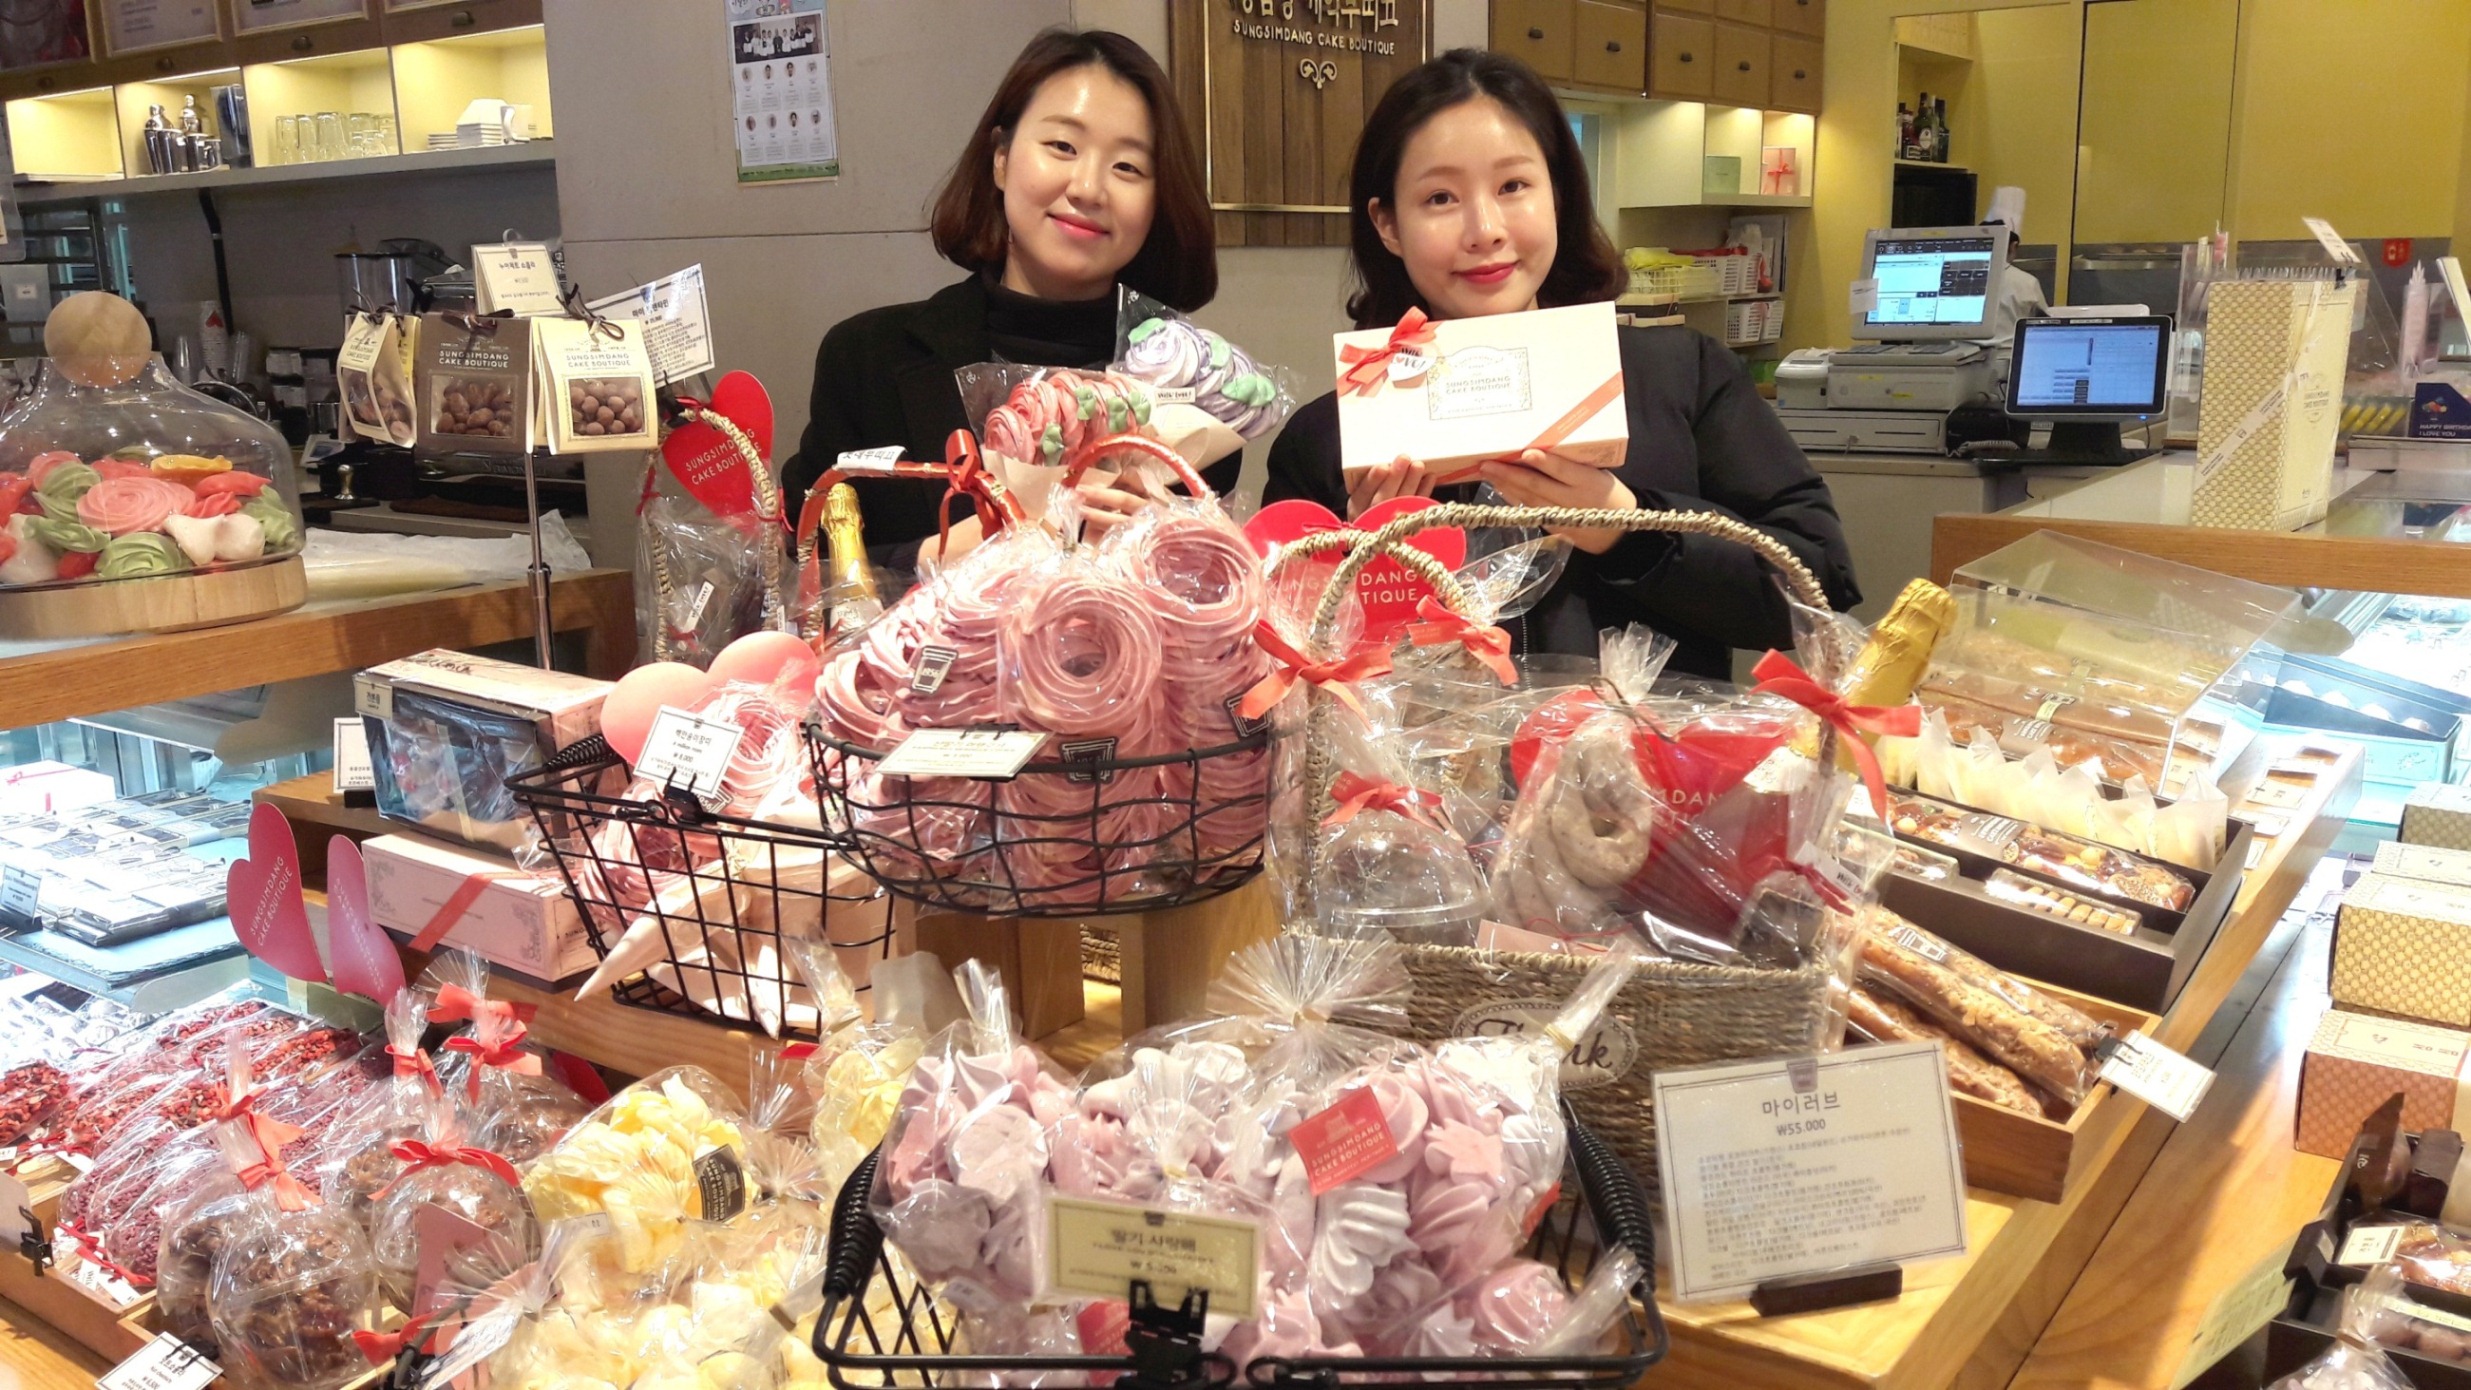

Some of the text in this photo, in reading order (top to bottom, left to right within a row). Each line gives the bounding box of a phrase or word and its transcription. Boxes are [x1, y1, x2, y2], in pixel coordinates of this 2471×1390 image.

[1233, 19, 1395, 56] SUNGSIMDANG CAKE BOUTIQUE
[438, 350, 509, 361] SUNGSIMDANG
[438, 357, 509, 368] CAKE BOUTIQUE
[566, 352, 630, 361] SUNGSIMDANG
[1446, 375, 1511, 389] SUNGSIMDANG
[1446, 382, 1511, 395] CAKE BOUTIQUE
[691, 466, 716, 486] CAKE
[249, 855, 285, 937] SUNGSIMDANG
[256, 865, 294, 947] CAKE BOUTIQUE
[1761, 1091, 1842, 1118] 마이러브
[1311, 1122, 1382, 1168] SUNGSIMDANG
[1314, 1158, 1340, 1177] CAKE
[1340, 1130, 1385, 1164] BOUTIQUE
